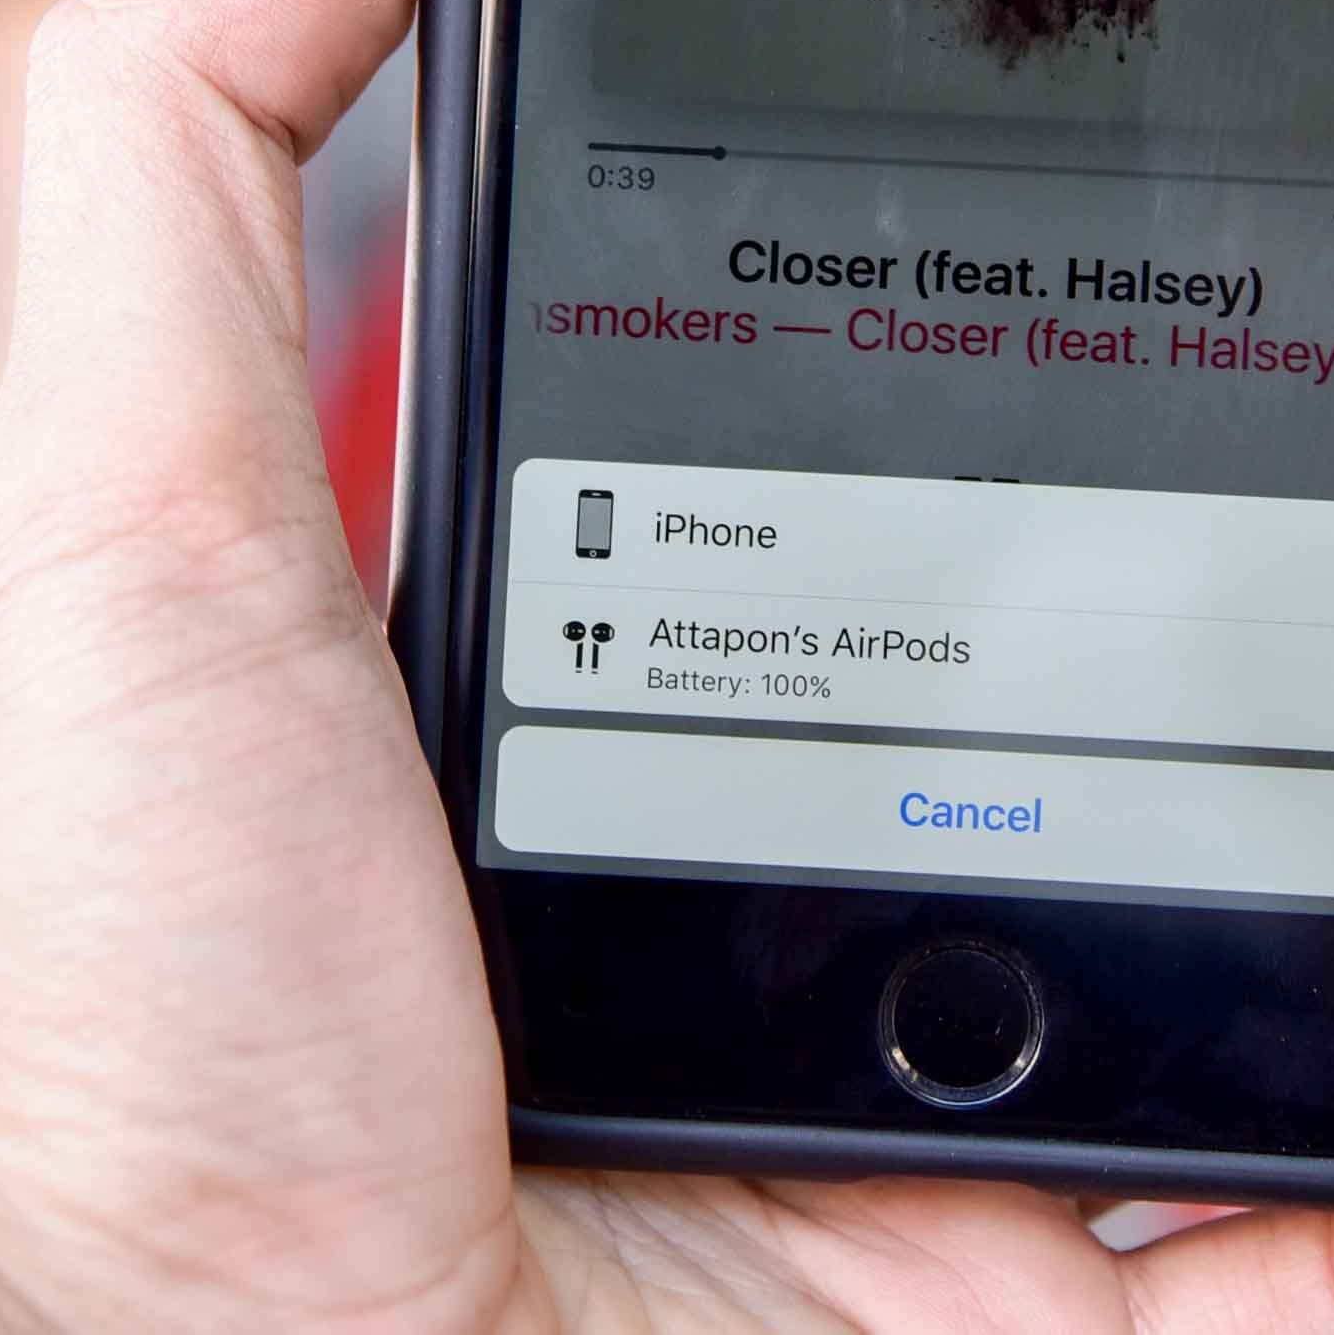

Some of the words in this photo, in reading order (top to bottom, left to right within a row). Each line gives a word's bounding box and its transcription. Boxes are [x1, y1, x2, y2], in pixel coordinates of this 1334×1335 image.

[586, 163, 656, 192] 0:39
[727, 238, 900, 292] Closer
[914, 248, 1049, 301] (feat.
[1065, 257, 1264, 319] Halsey)
[846, 306, 1010, 358] Closer
[1025, 316, 1151, 368] (feat.
[654, 511, 778, 550] iPhone
[648, 616, 820, 659] Attapon’s
[830, 625, 972, 665] AirPods
[646, 667, 751, 699] Battery:
[760, 673, 832, 700] 100%
[898, 791, 1044, 834] Cancel
